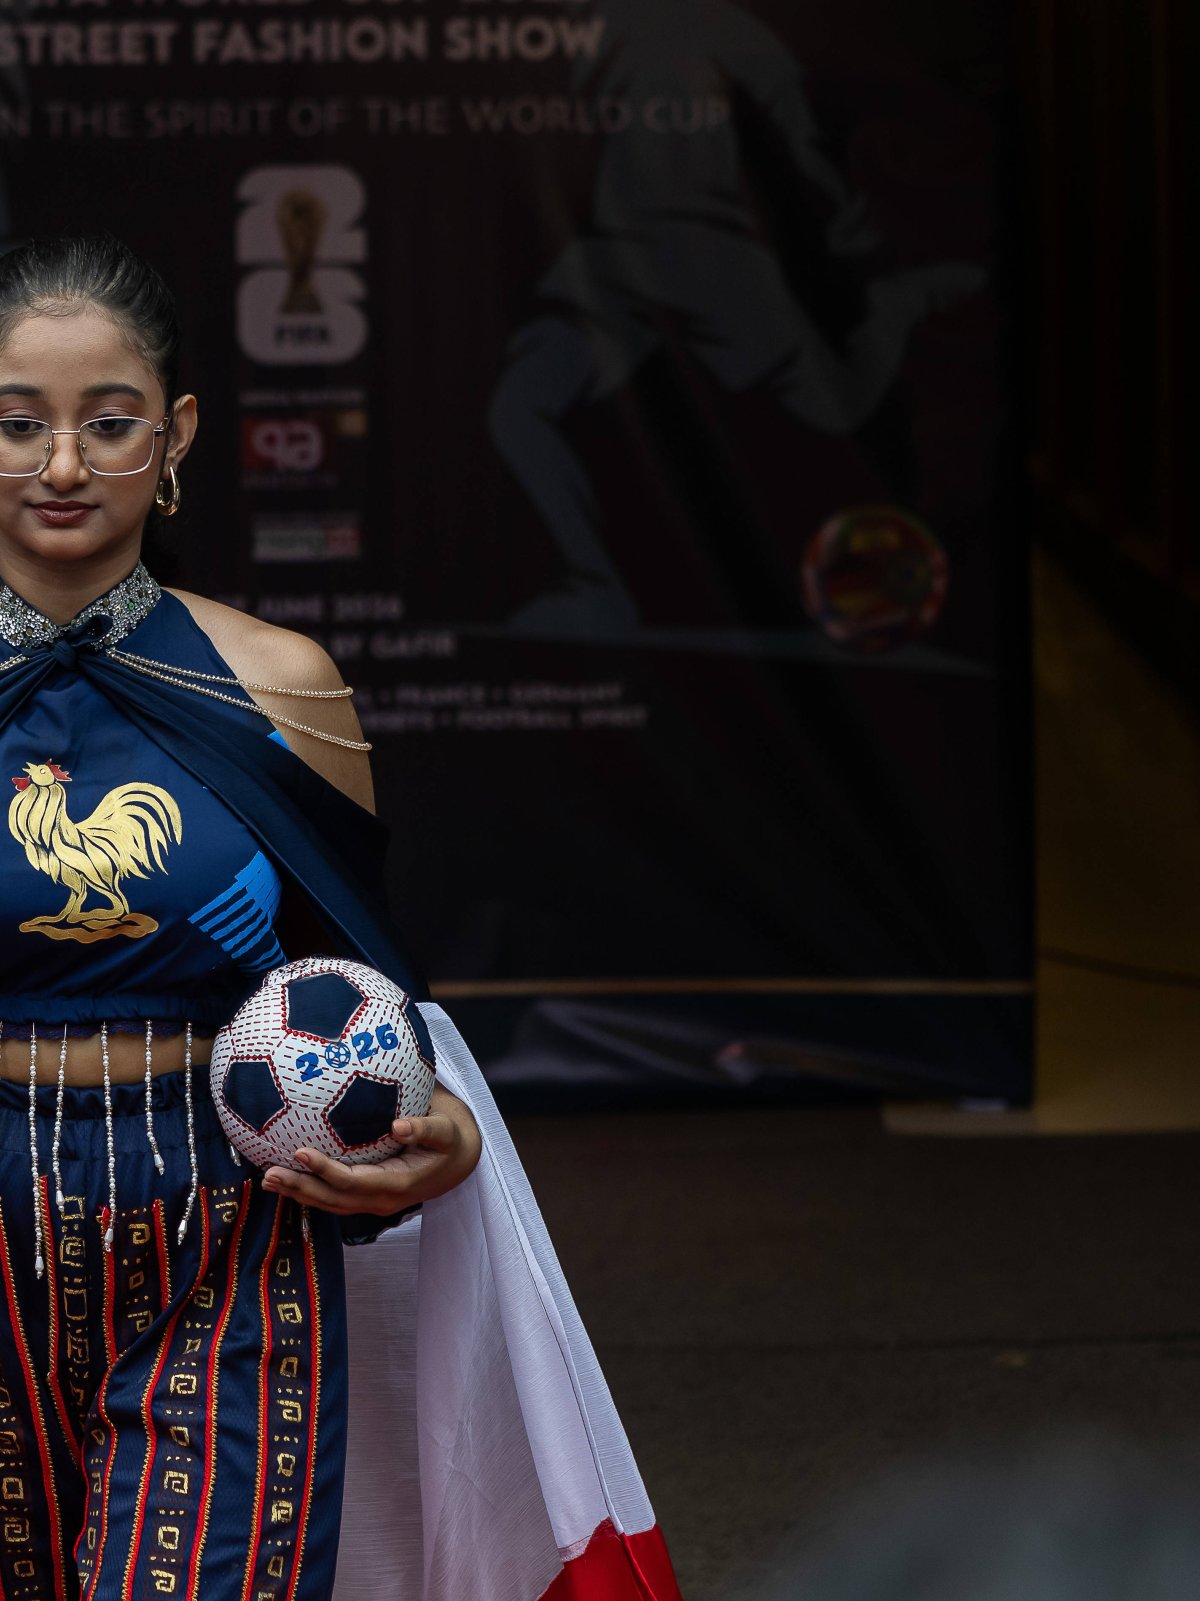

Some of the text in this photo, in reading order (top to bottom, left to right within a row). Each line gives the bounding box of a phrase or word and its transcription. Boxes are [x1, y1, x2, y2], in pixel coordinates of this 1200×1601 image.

[192, 18, 429, 65] FASHION
[443, 16, 607, 62] SHOW
[46, 101, 130, 139] THE
[144, 99, 280, 138] SPIRIT
[286, 97, 349, 137] OF
[360, 97, 451, 135] THE
[461, 96, 631, 135] WORLD
[642, 95, 730, 134] CUP
